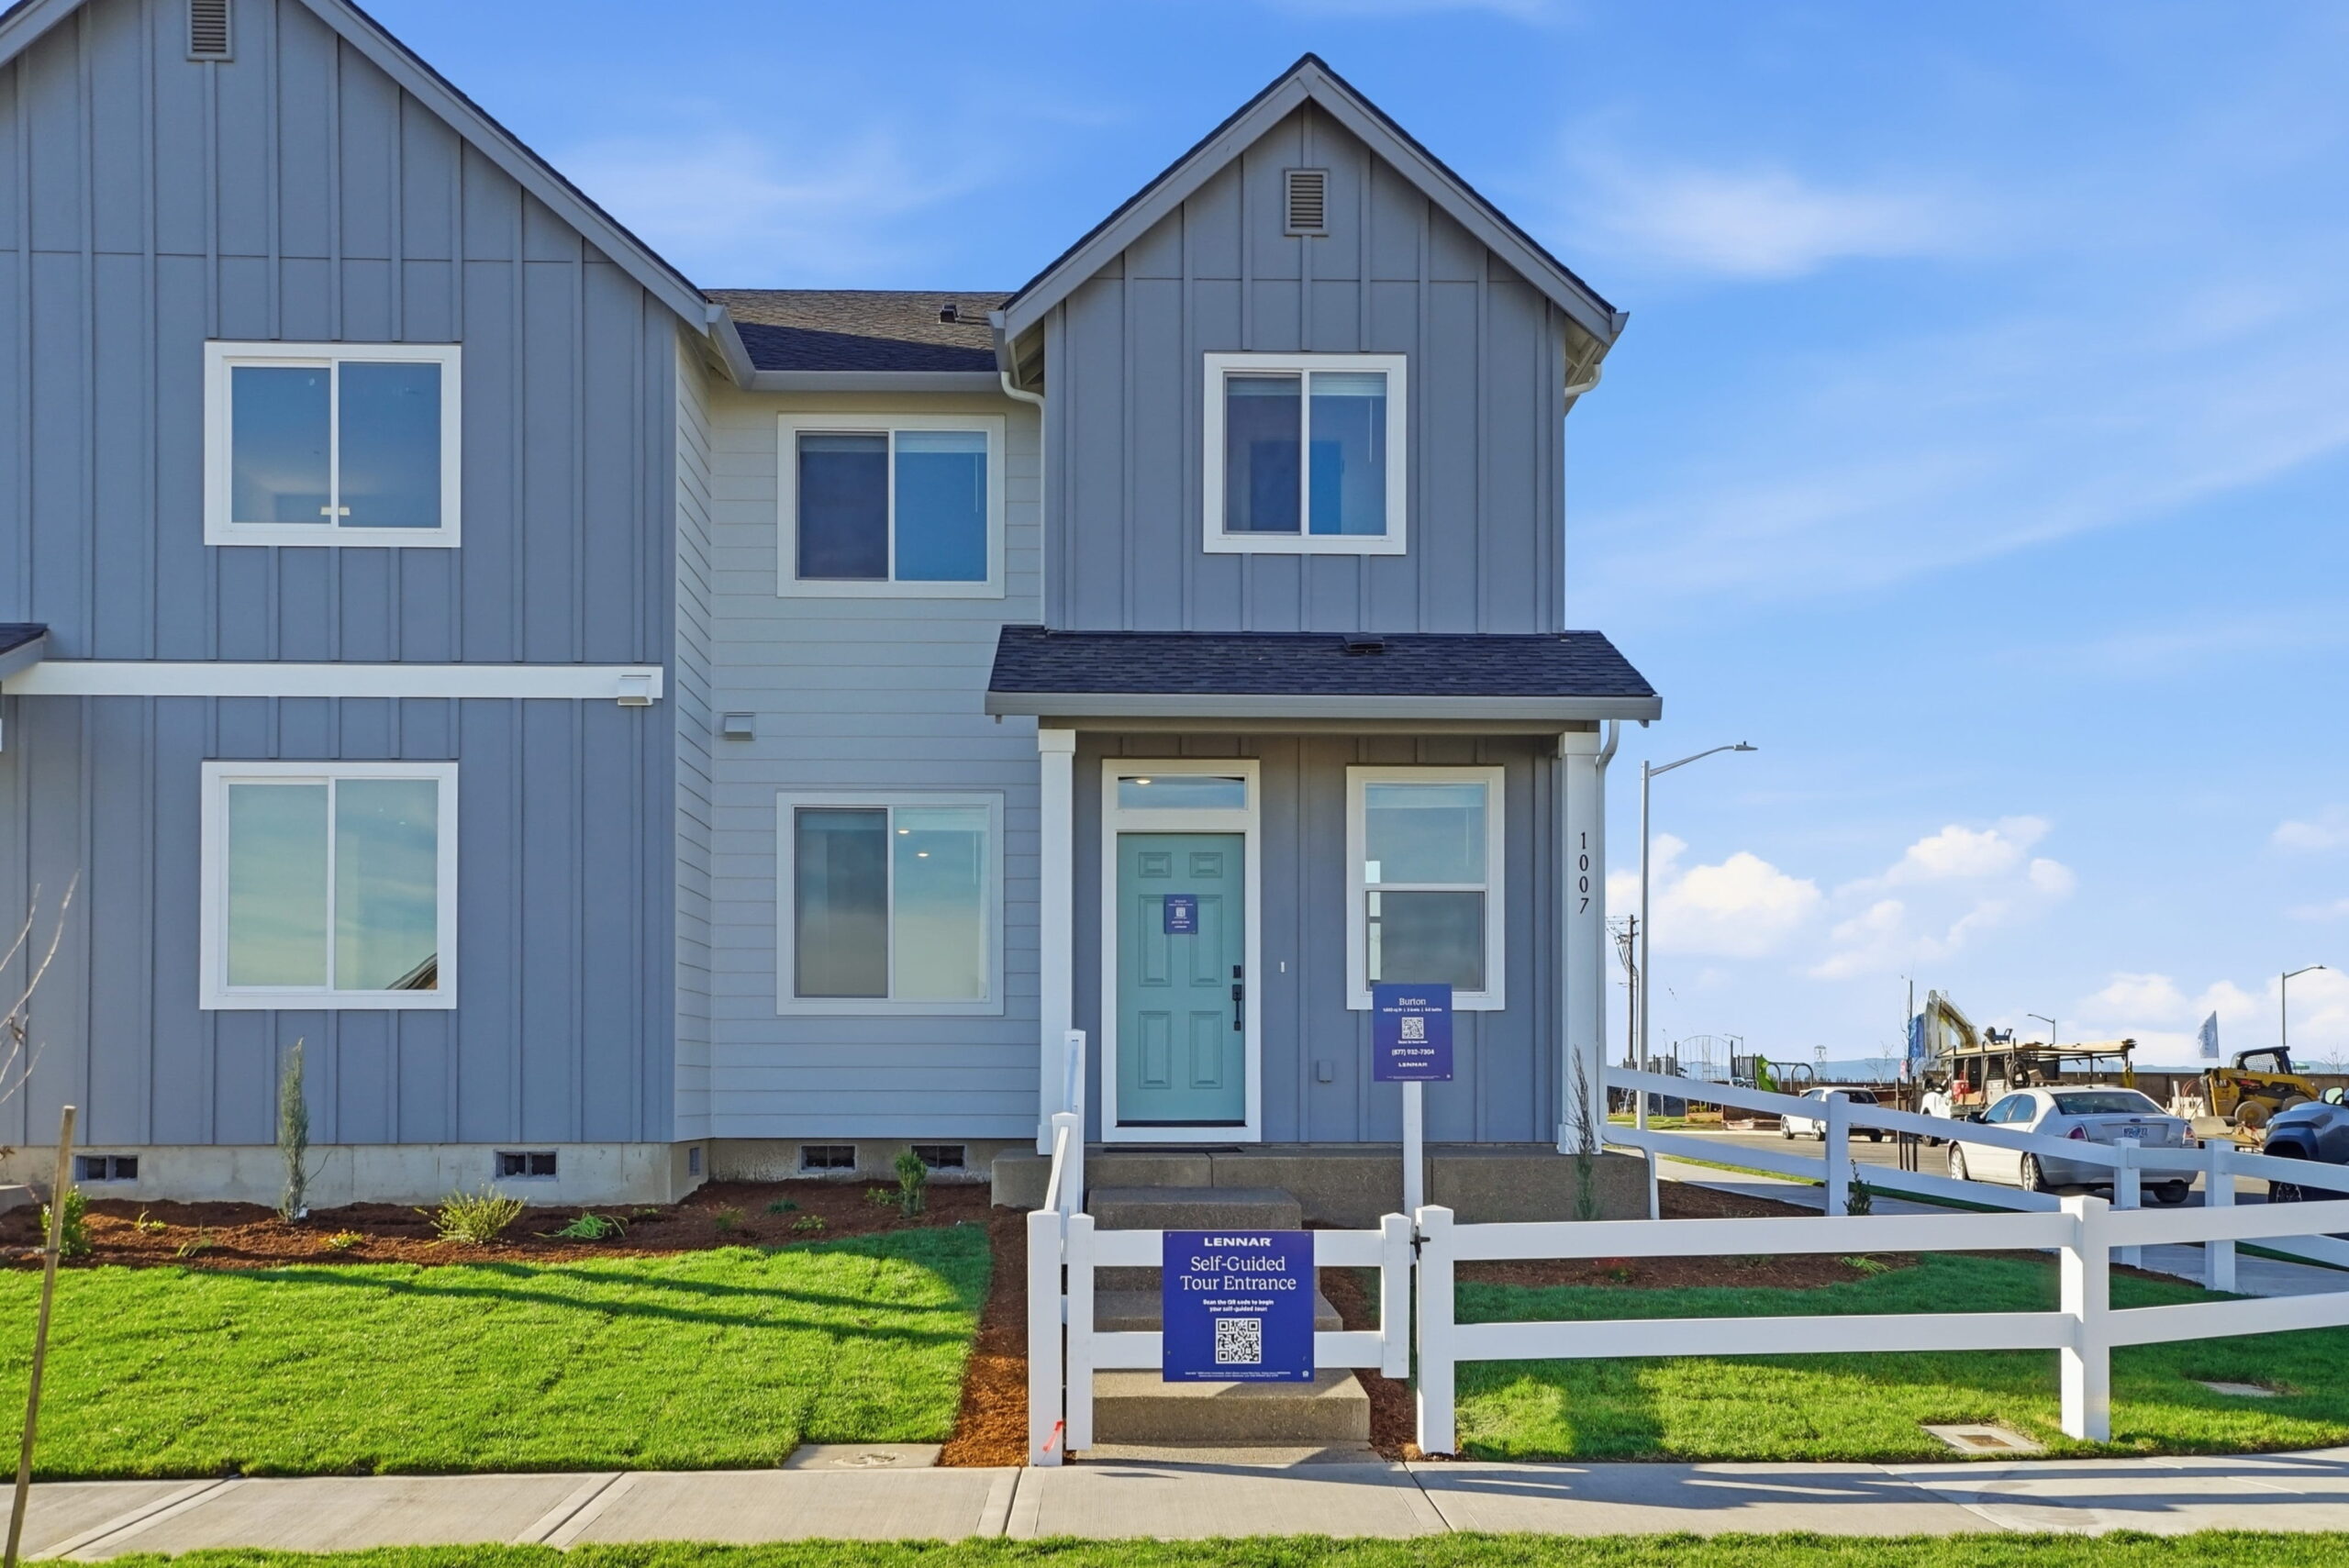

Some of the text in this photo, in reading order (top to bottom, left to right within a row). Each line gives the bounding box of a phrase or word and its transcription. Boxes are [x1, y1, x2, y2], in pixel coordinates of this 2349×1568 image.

[1579, 831, 1589, 915] 1007
[1398, 997, 1426, 1006] Burton
[1204, 1238, 1272, 1247] LENNAR
[1190, 1255, 1286, 1272] Self-Guided
[1180, 1275, 1297, 1290] Tour Entrance
